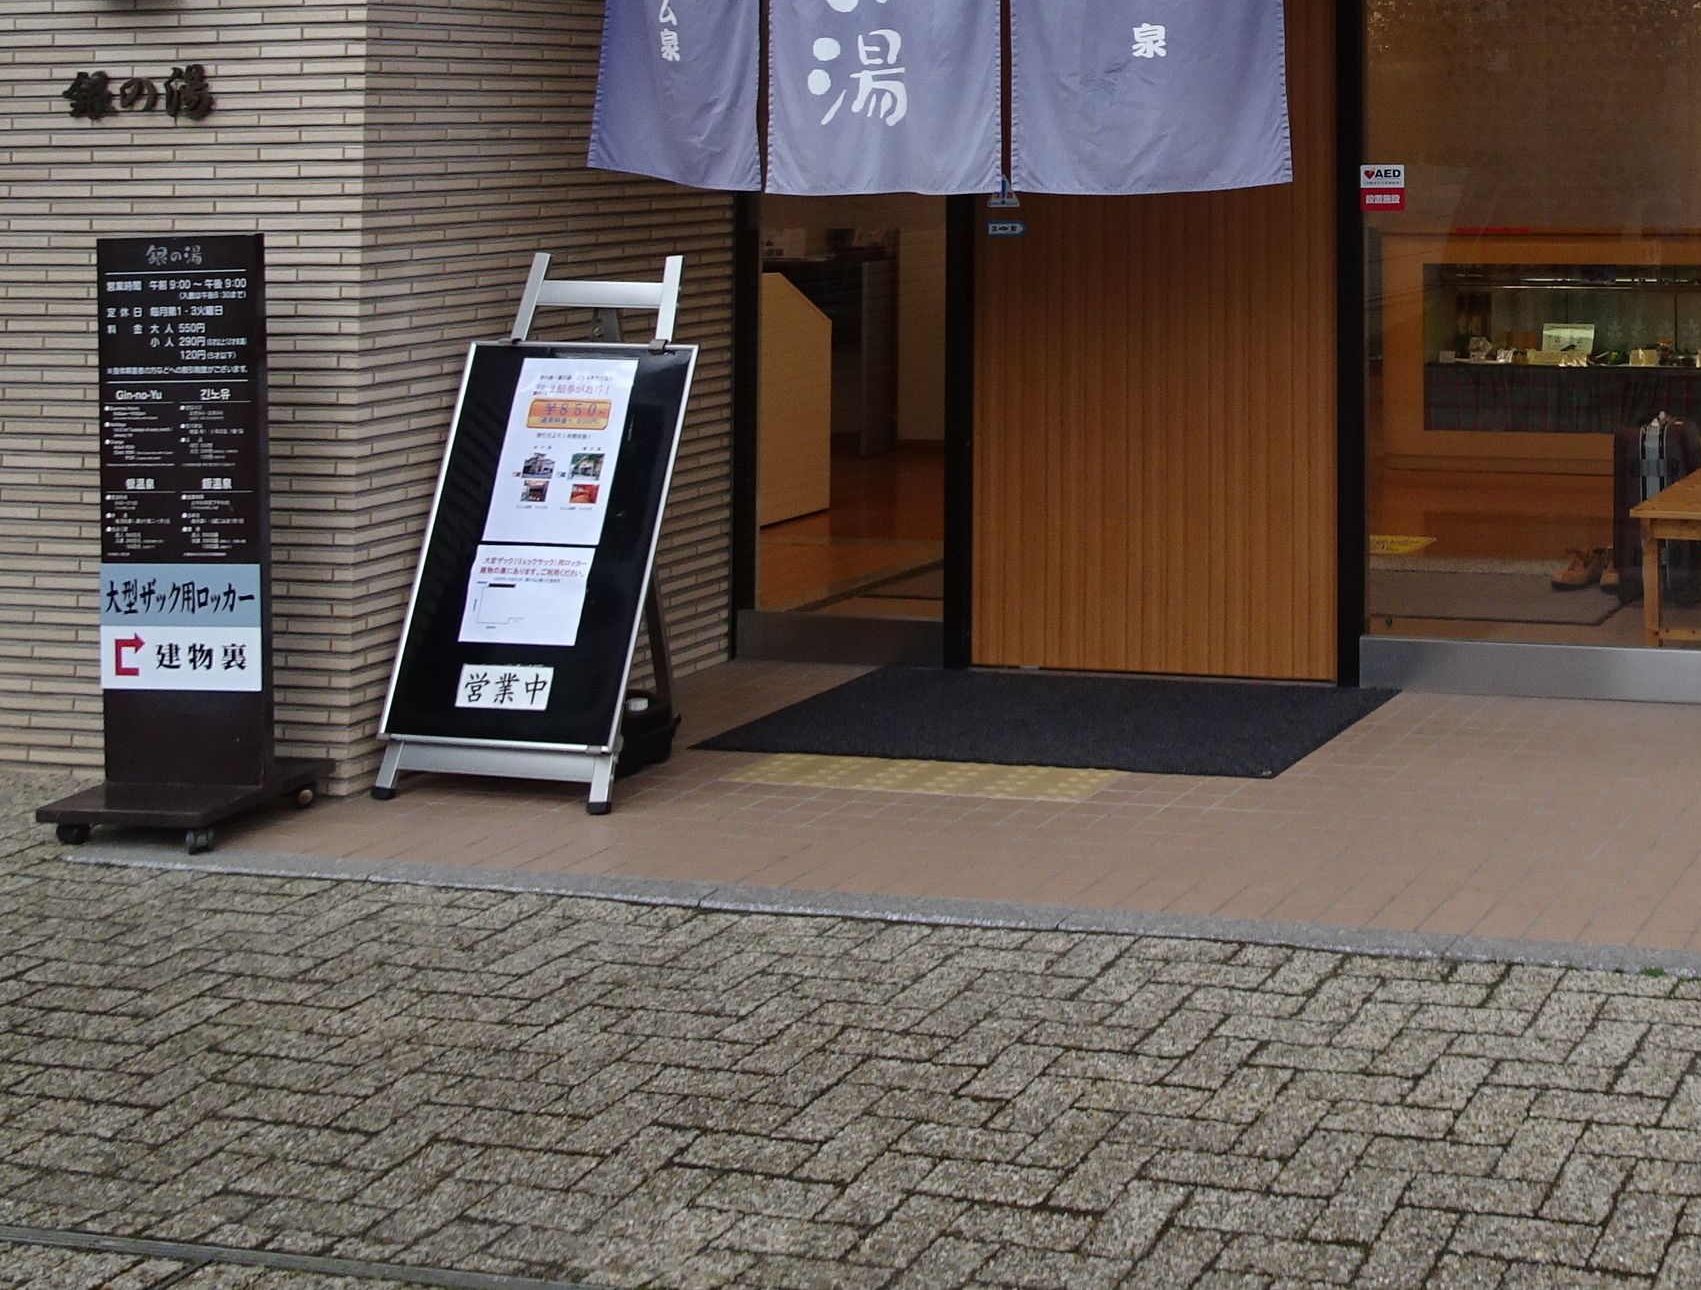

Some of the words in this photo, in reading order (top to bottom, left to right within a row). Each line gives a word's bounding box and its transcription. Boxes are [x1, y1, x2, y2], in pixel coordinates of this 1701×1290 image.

[62, 63, 217, 121] 銀の湯
[1375, 169, 1401, 178] AED
[146, 244, 203, 266] 銀の湯
[106, 307, 143, 318] 定休日
[178, 322, 206, 333] 550円
[180, 350, 206, 360] 120円
[115, 390, 162, 400] Gin-no-Yu
[105, 577, 255, 615] 大型ザック用ロッカー
[156, 642, 248, 671] 建物裏
[464, 671, 548, 706] 営業中
